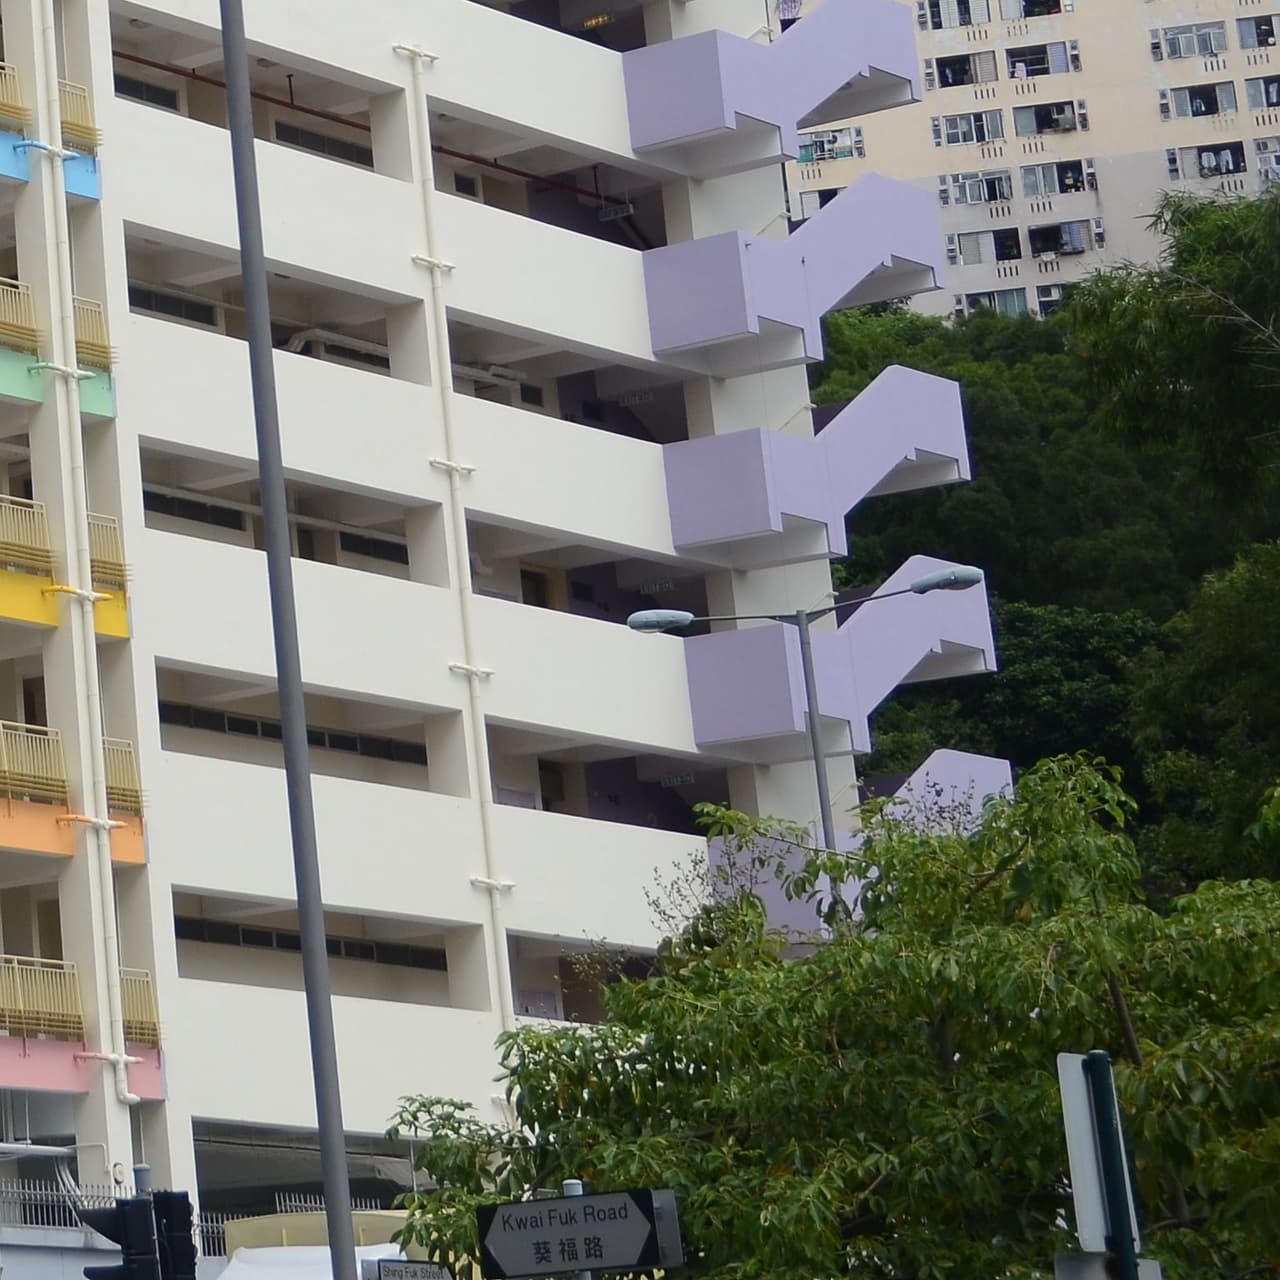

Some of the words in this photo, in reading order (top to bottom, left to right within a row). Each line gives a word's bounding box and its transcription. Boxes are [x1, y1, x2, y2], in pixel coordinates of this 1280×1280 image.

[501, 1211, 544, 1232] Kwai
[548, 1207, 578, 1226] Fuk
[583, 1202, 628, 1223] Road
[532, 1234, 604, 1264] 葵福路
